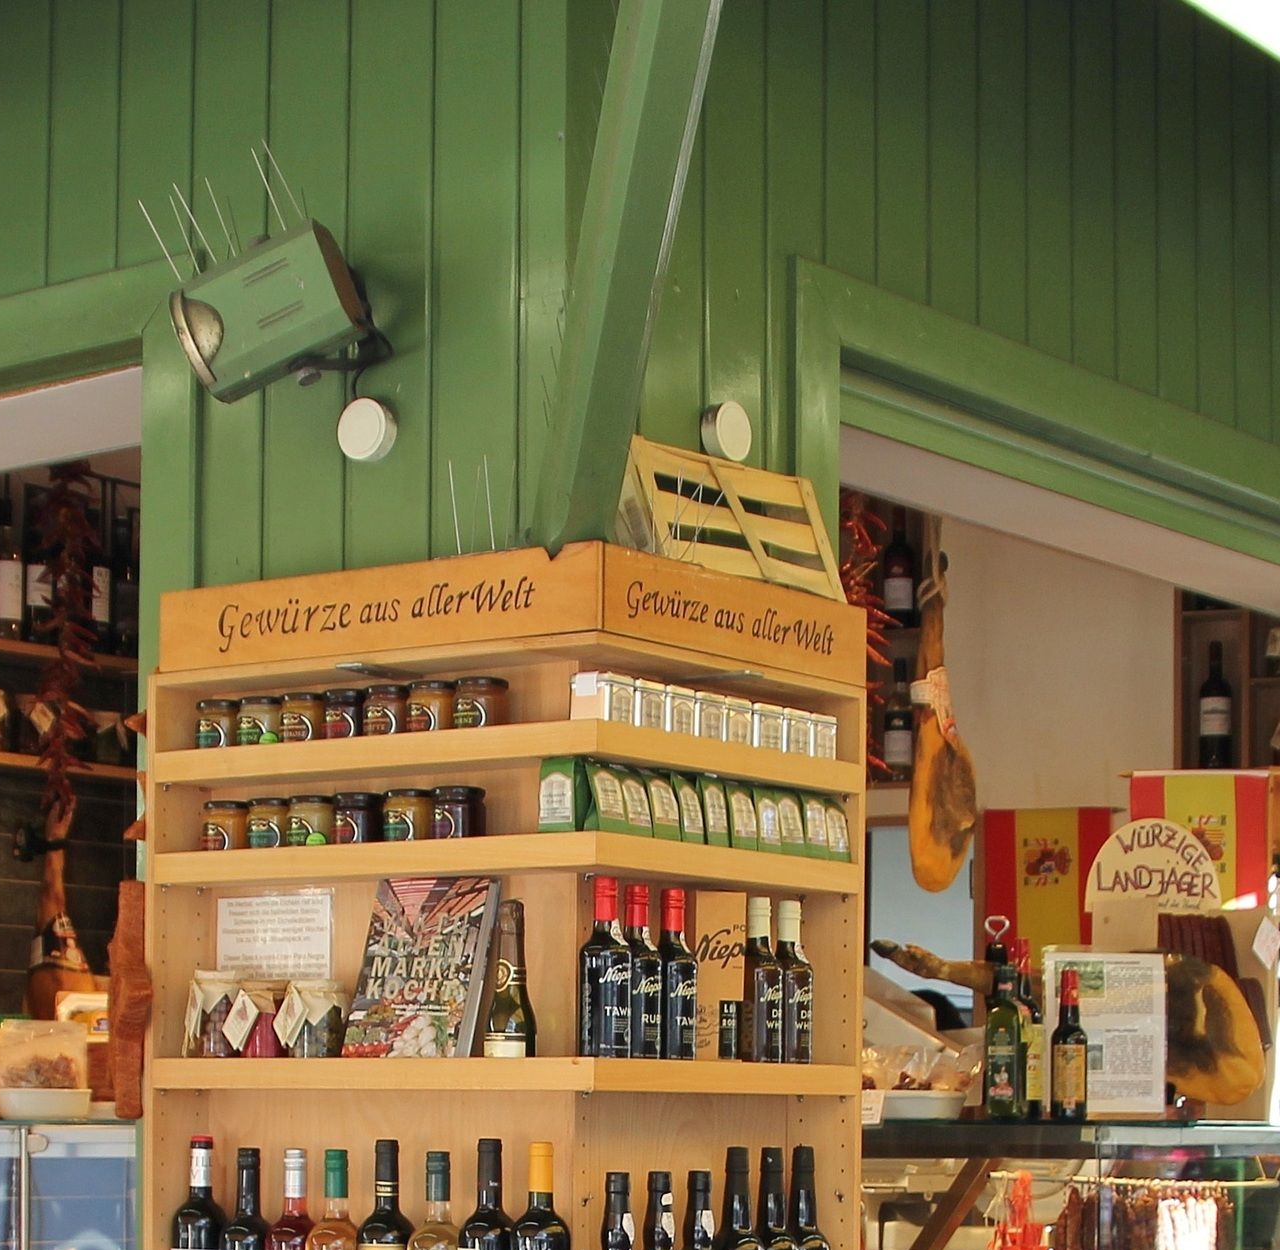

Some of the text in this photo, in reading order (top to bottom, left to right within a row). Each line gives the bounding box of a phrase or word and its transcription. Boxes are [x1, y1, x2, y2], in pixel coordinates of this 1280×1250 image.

[218, 598, 351, 653] Gewürze
[360, 599, 400, 624] aus
[627, 581, 708, 623] Gewürze
[714, 609, 744, 633] aus
[1115, 822, 1209, 873] WÜRZIGE
[1096, 860, 1217, 899] LANDJÄGER
